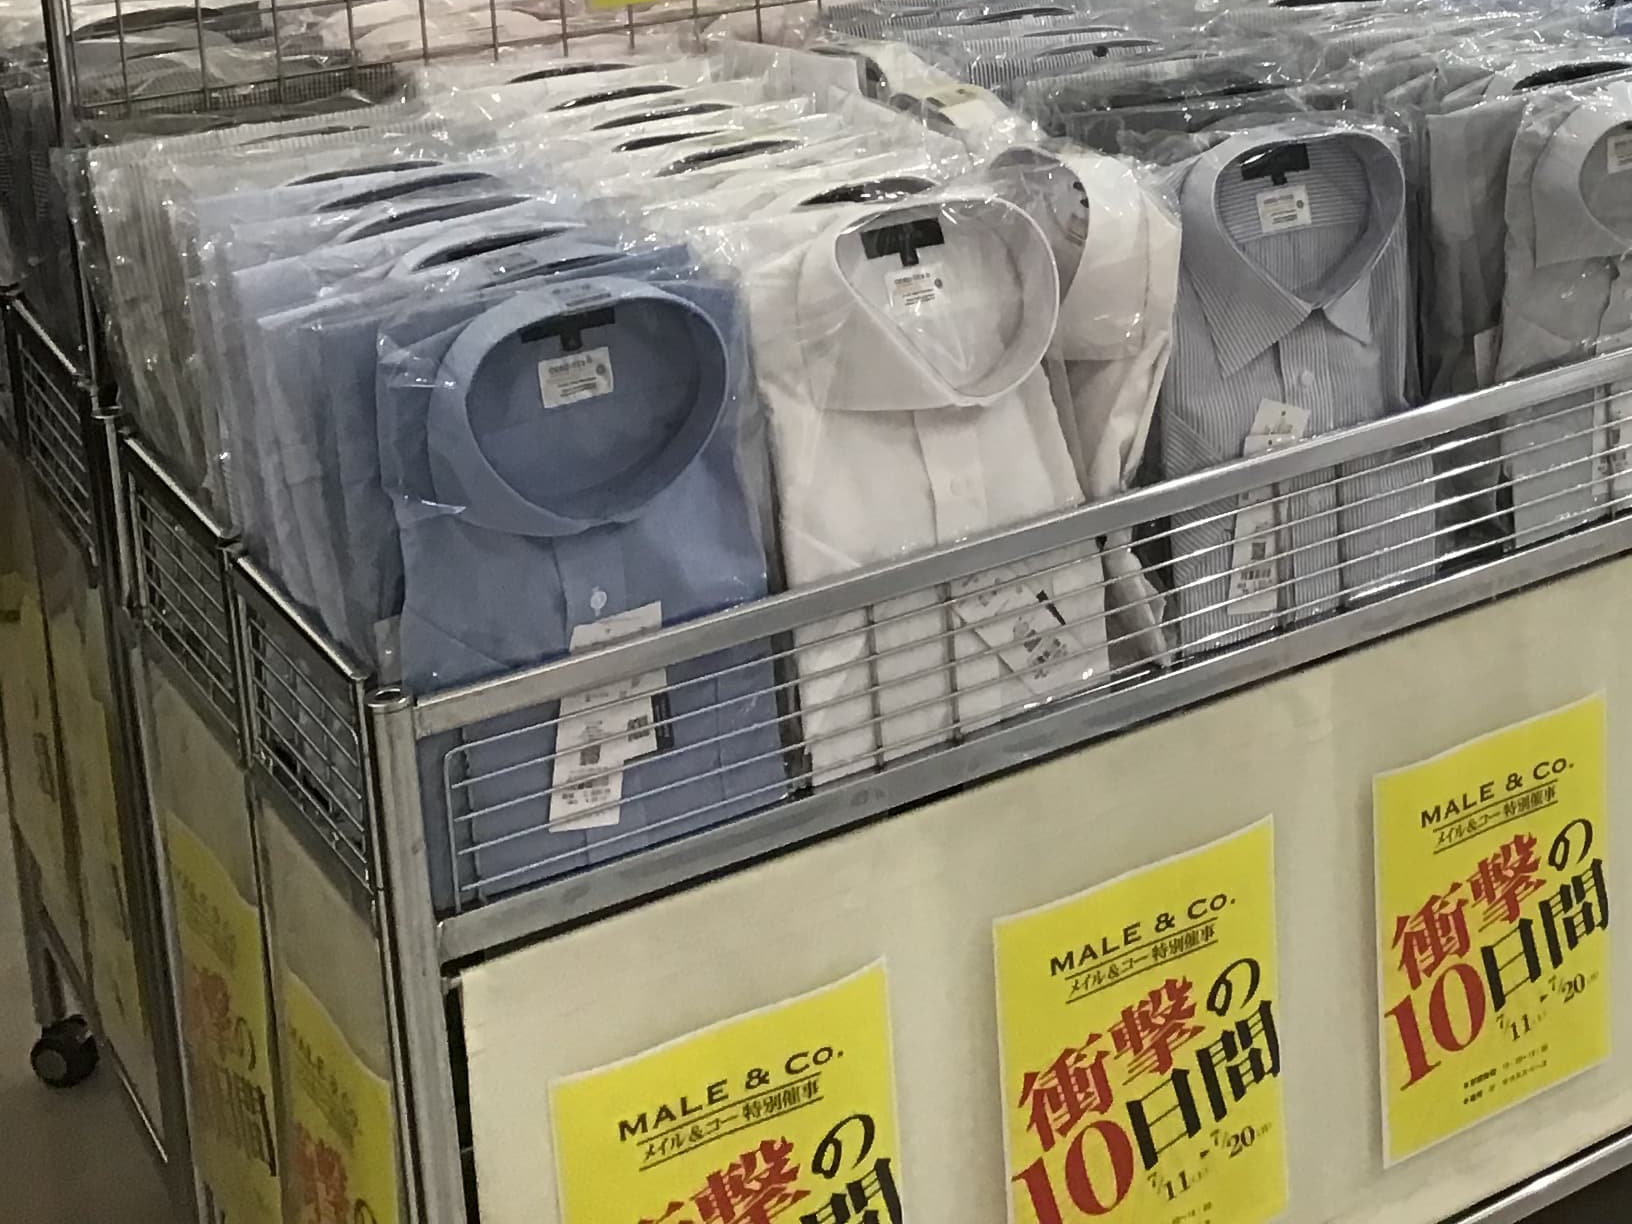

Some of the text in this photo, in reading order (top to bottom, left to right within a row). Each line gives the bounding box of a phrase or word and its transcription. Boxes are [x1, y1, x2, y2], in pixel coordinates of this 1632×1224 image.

[1420, 780, 1496, 829] MALE
[1505, 772, 1524, 792] &
[1050, 921, 1143, 977] MALE
[1154, 912, 1176, 934] &
[1384, 857, 1611, 1093] 10日間
[1391, 817, 1594, 991] 衝撃の
[617, 1079, 730, 1142] MALE
[744, 1067, 770, 1090] &
[1011, 999, 1281, 1224] 10日間
[1018, 957, 1262, 1152] 衝撃の
[638, 1113, 876, 1224] 撃の
